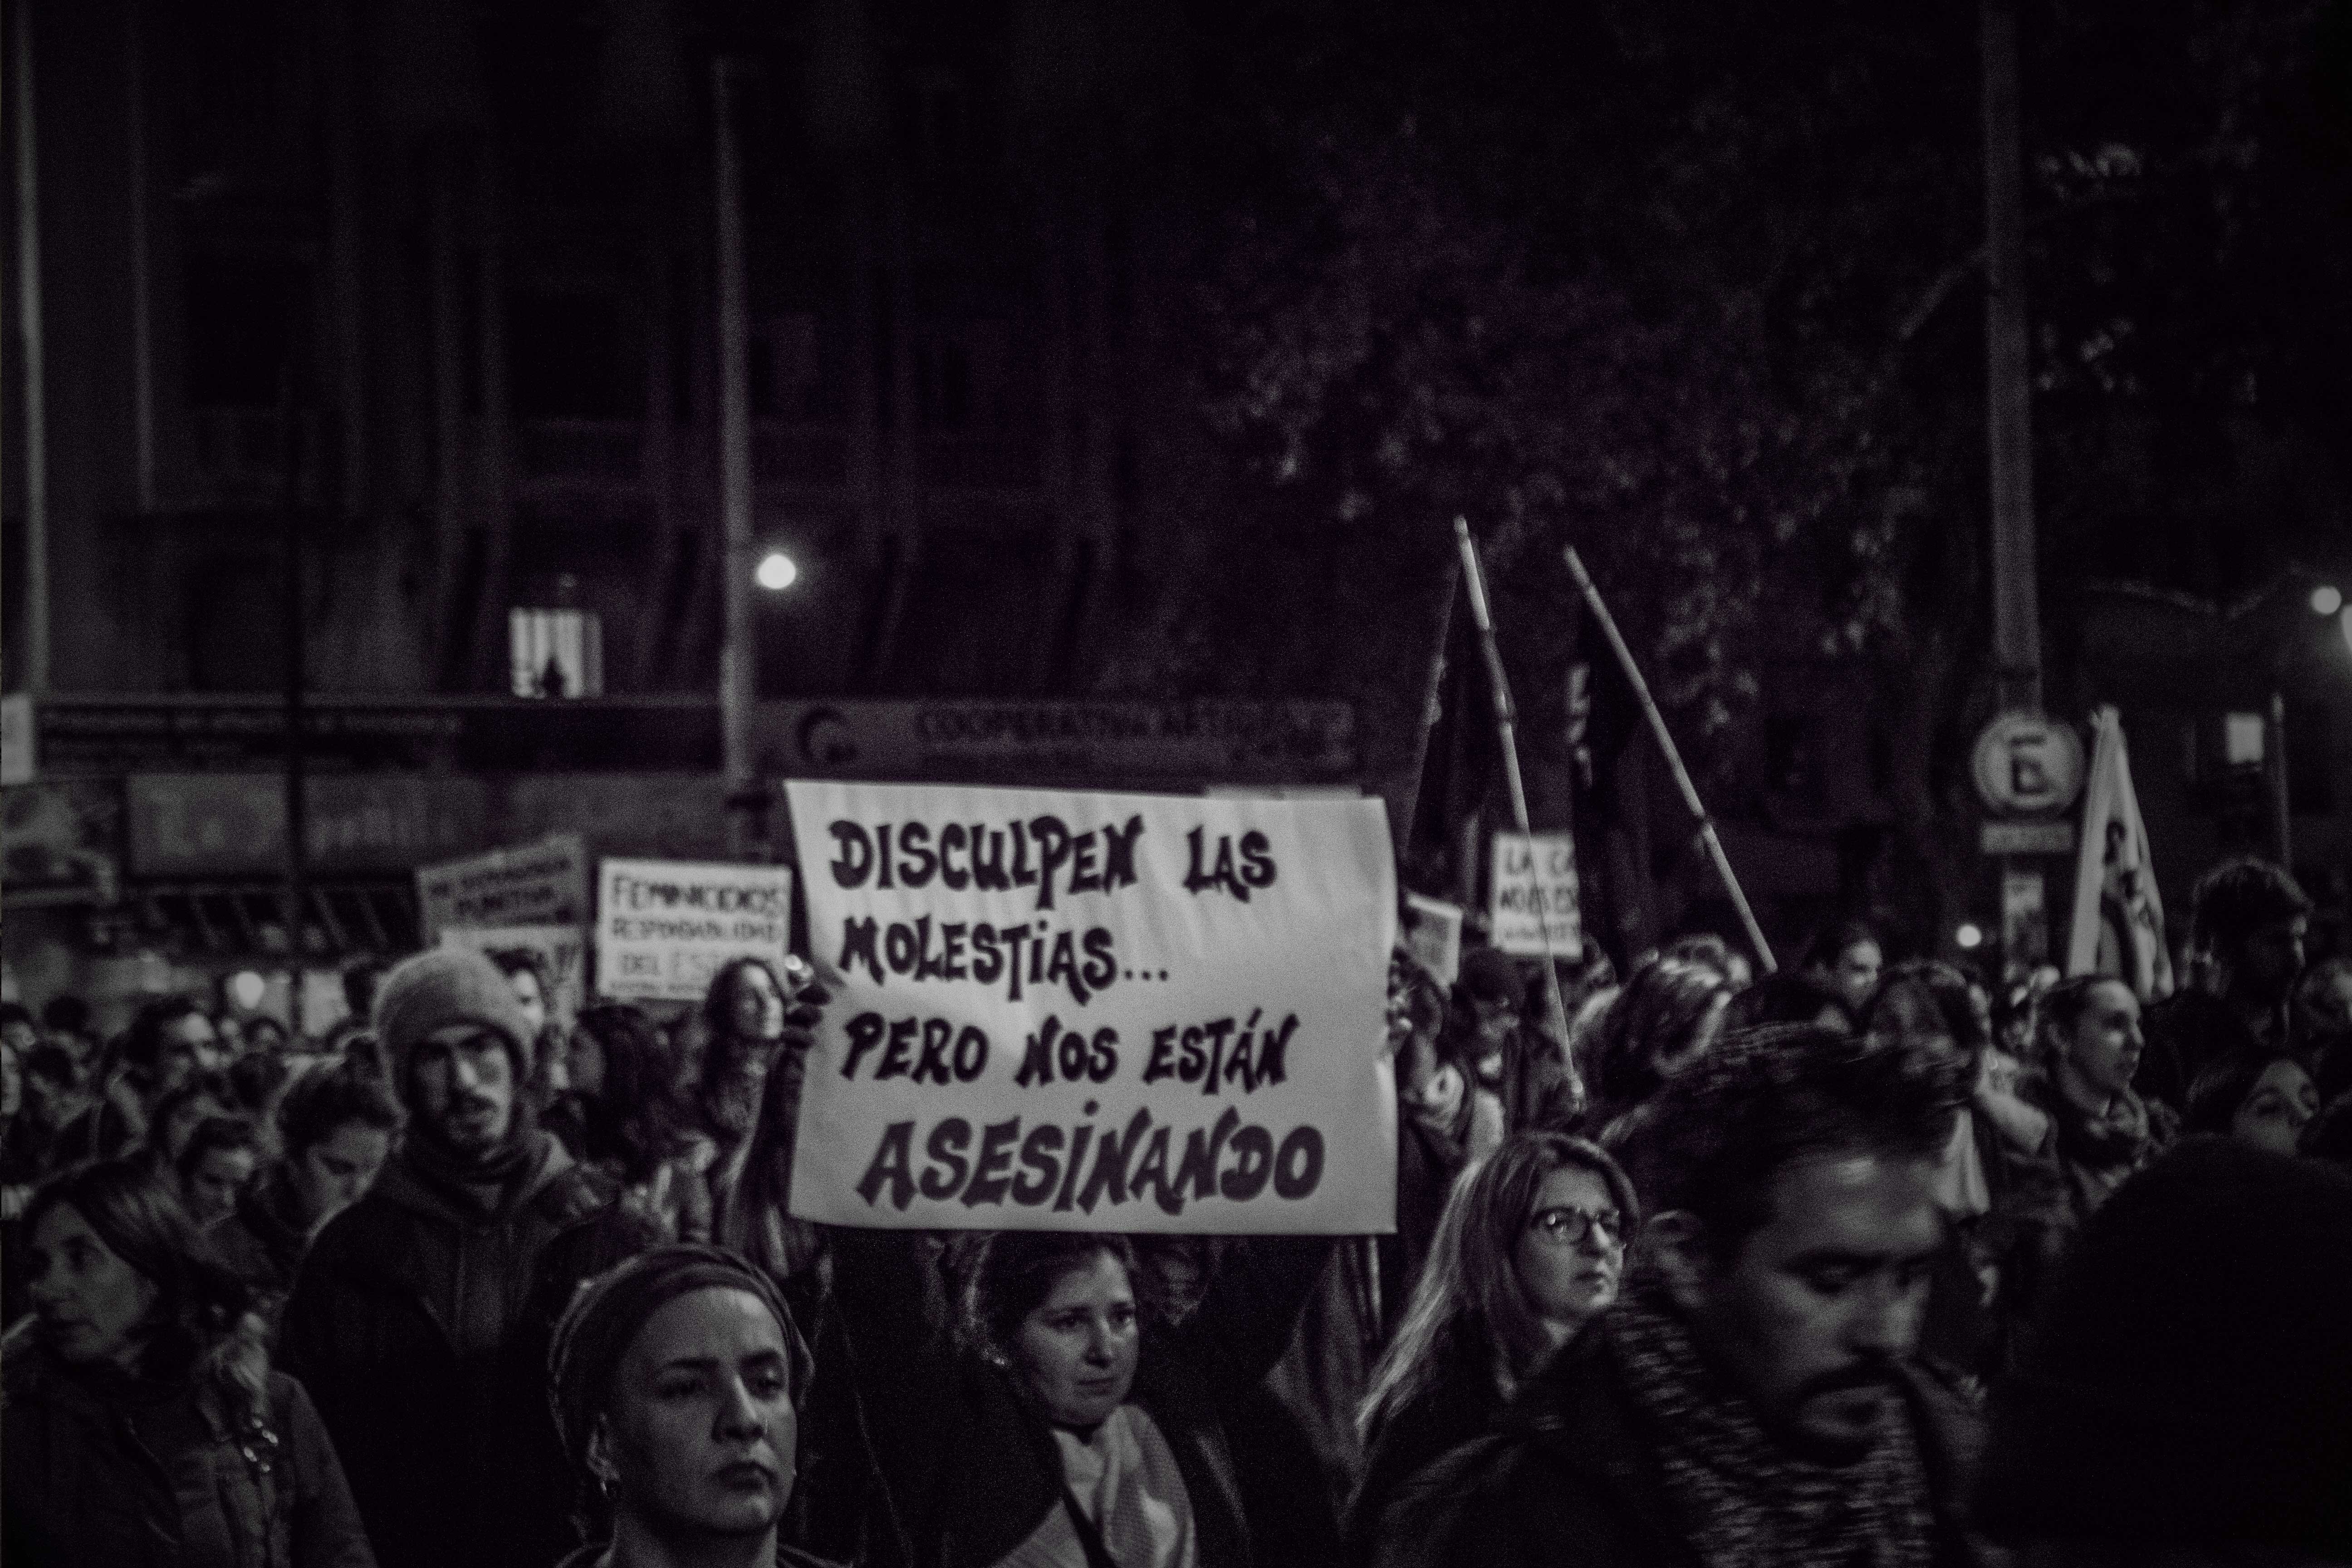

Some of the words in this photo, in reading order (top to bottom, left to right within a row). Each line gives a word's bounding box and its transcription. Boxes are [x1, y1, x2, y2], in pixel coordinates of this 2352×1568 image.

[830, 815, 1143, 909] DISCULPEN
[1184, 824, 1276, 902] LAS
[840, 1011, 990, 1086] PERO
[1014, 1015, 1118, 1088] NOS
[1142, 1008, 1300, 1095] ESTÁN
